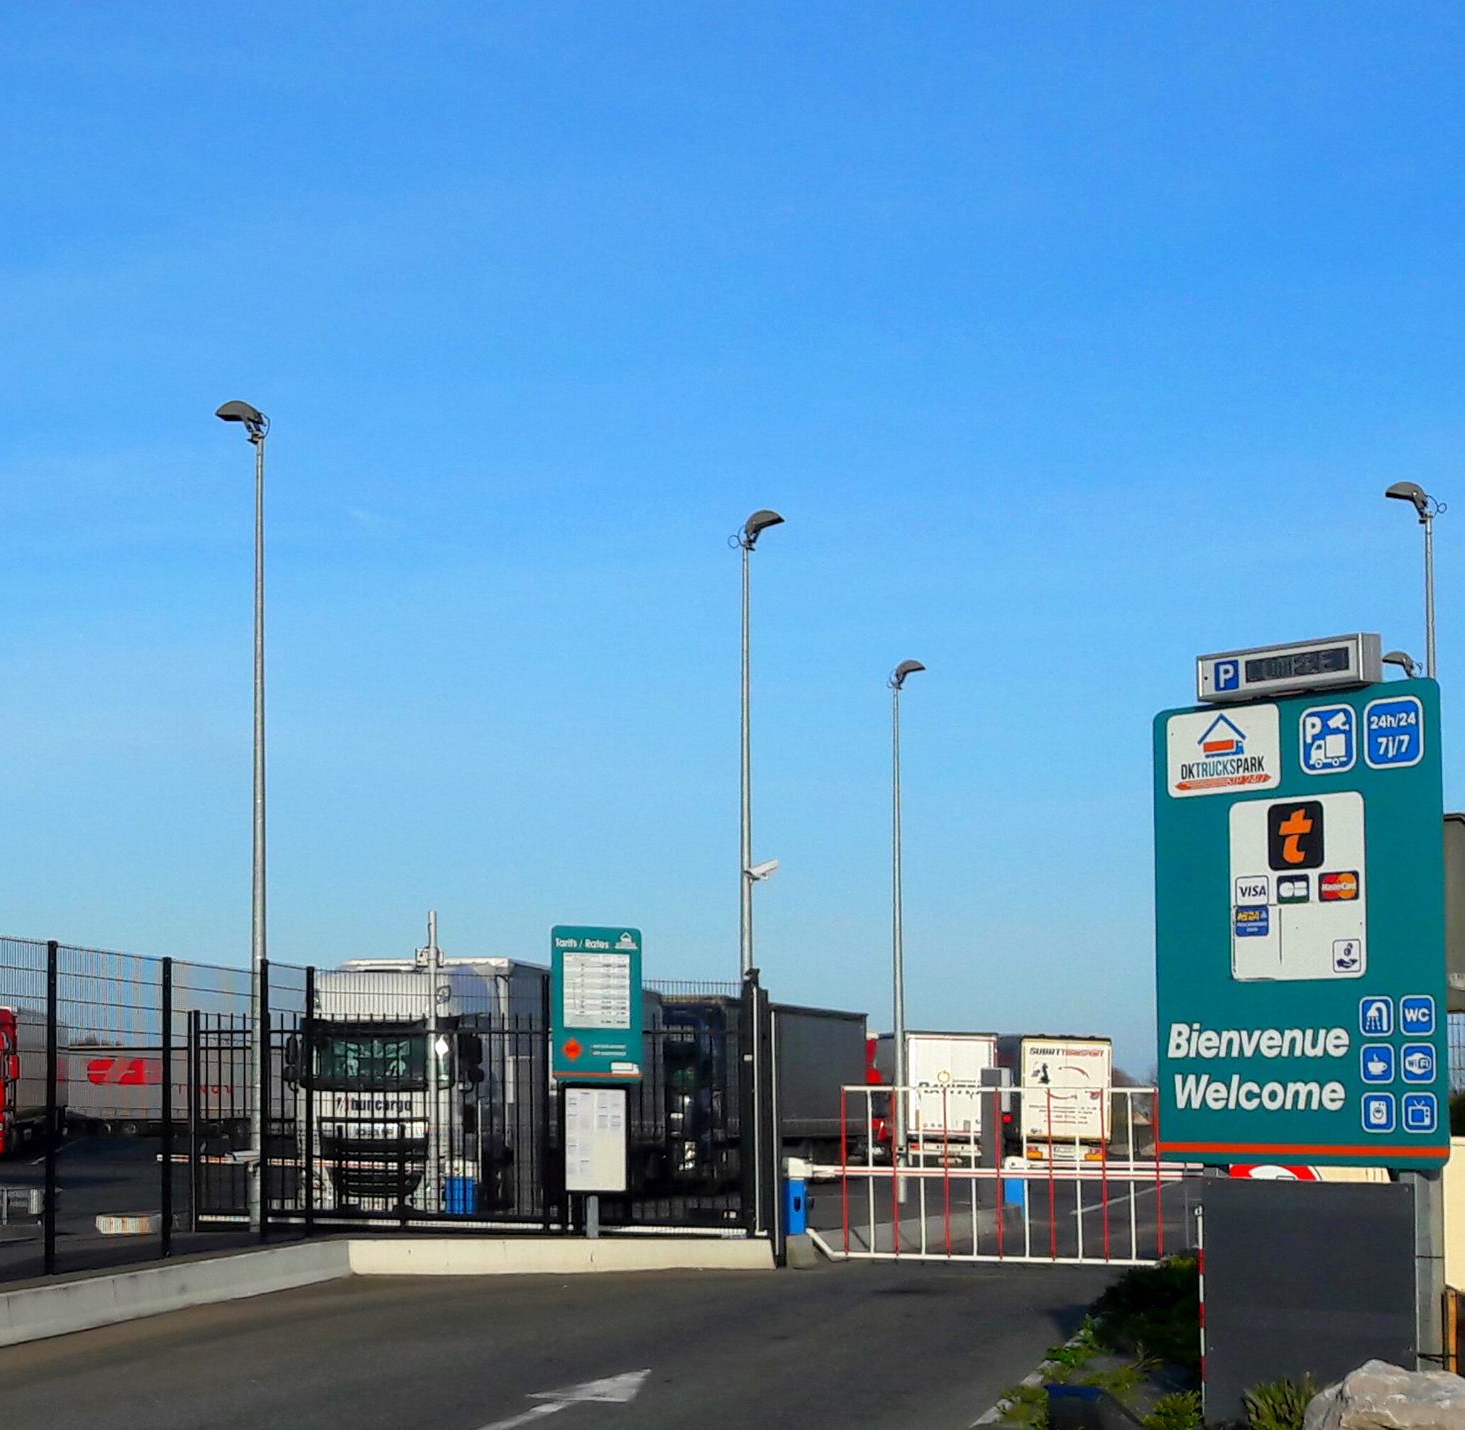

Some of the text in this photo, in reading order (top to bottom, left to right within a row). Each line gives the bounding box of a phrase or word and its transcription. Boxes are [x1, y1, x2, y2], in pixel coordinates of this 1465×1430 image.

[1370, 712, 1416, 729] 24h/24
[1378, 735, 1410, 758] 7j/7
[1181, 756, 1264, 780] OKTRUCKSPARK
[1239, 885, 1267, 897] VISA
[1405, 1008, 1430, 1022] WC
[1167, 1023, 1350, 1059] Bienvenue
[1174, 1074, 1346, 1111] Welcome
